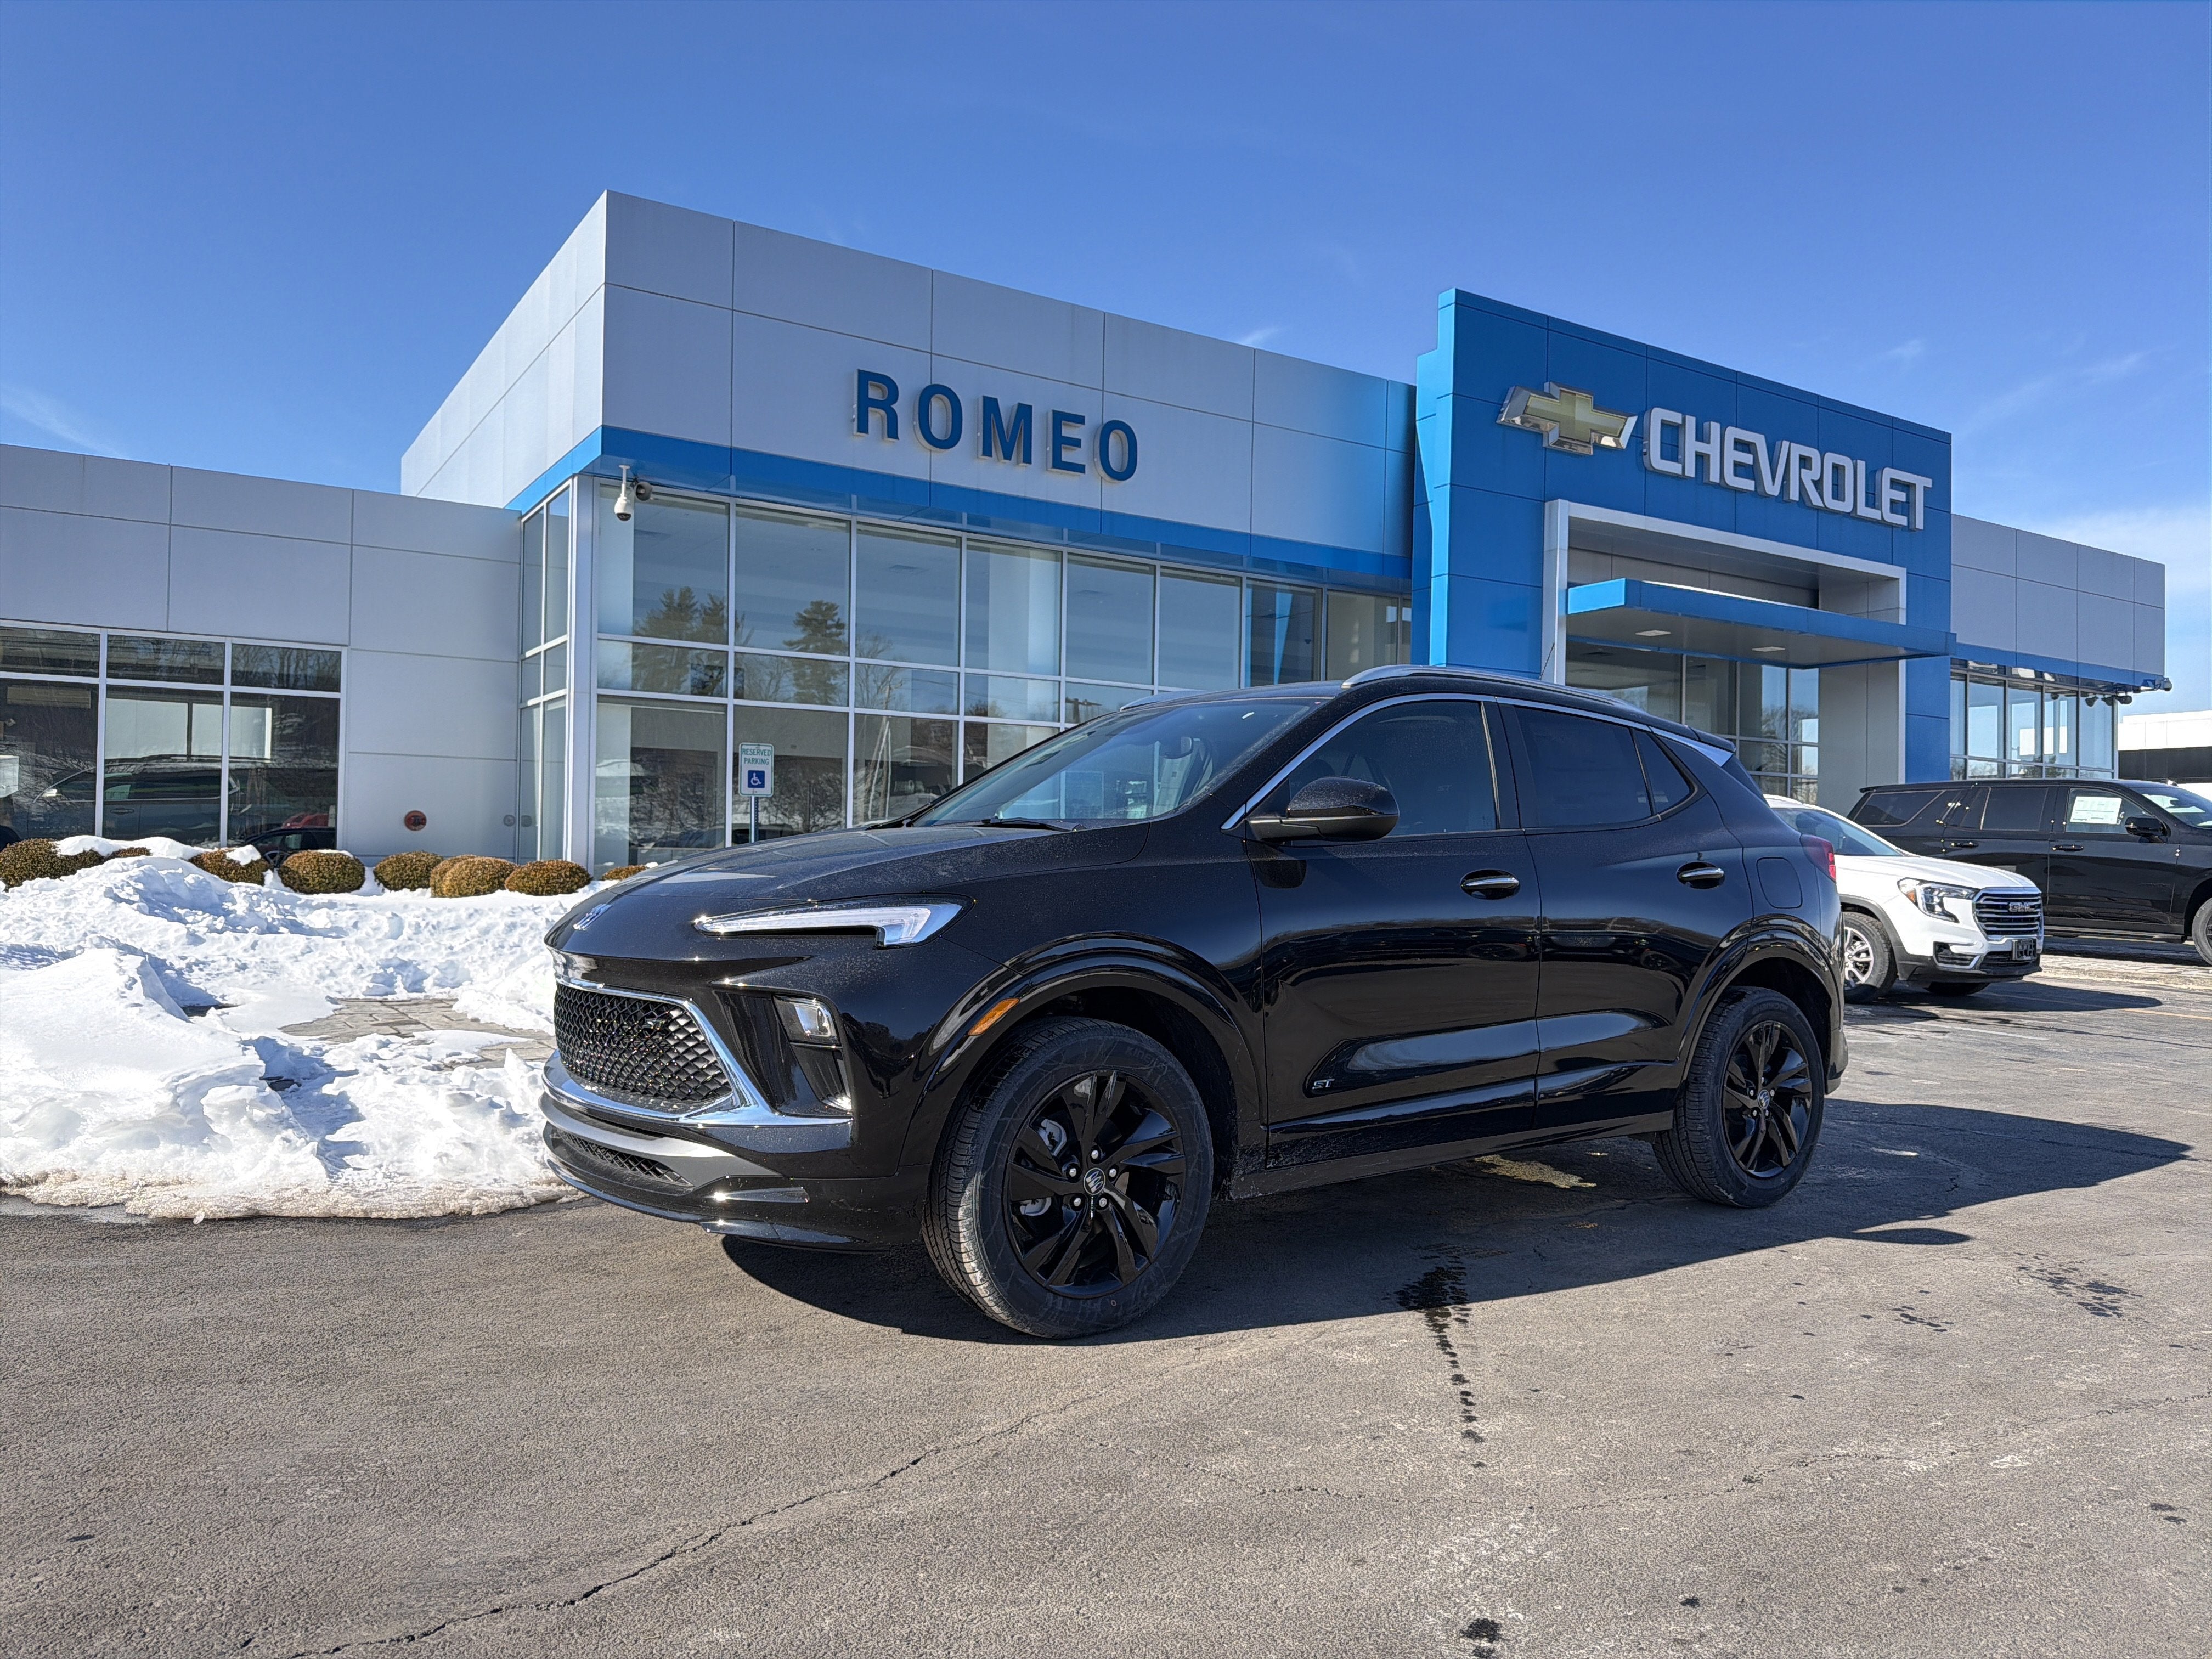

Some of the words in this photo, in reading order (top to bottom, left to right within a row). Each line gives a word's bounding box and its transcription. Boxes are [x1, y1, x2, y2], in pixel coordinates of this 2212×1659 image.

[854, 369, 1138, 482] ROMEO
[1646, 407, 1932, 531] CHEVROLET
[742, 748, 771, 757] RESERVED
[2009, 902, 2035, 912] GMC
[1312, 1078, 1335, 1090] ST
